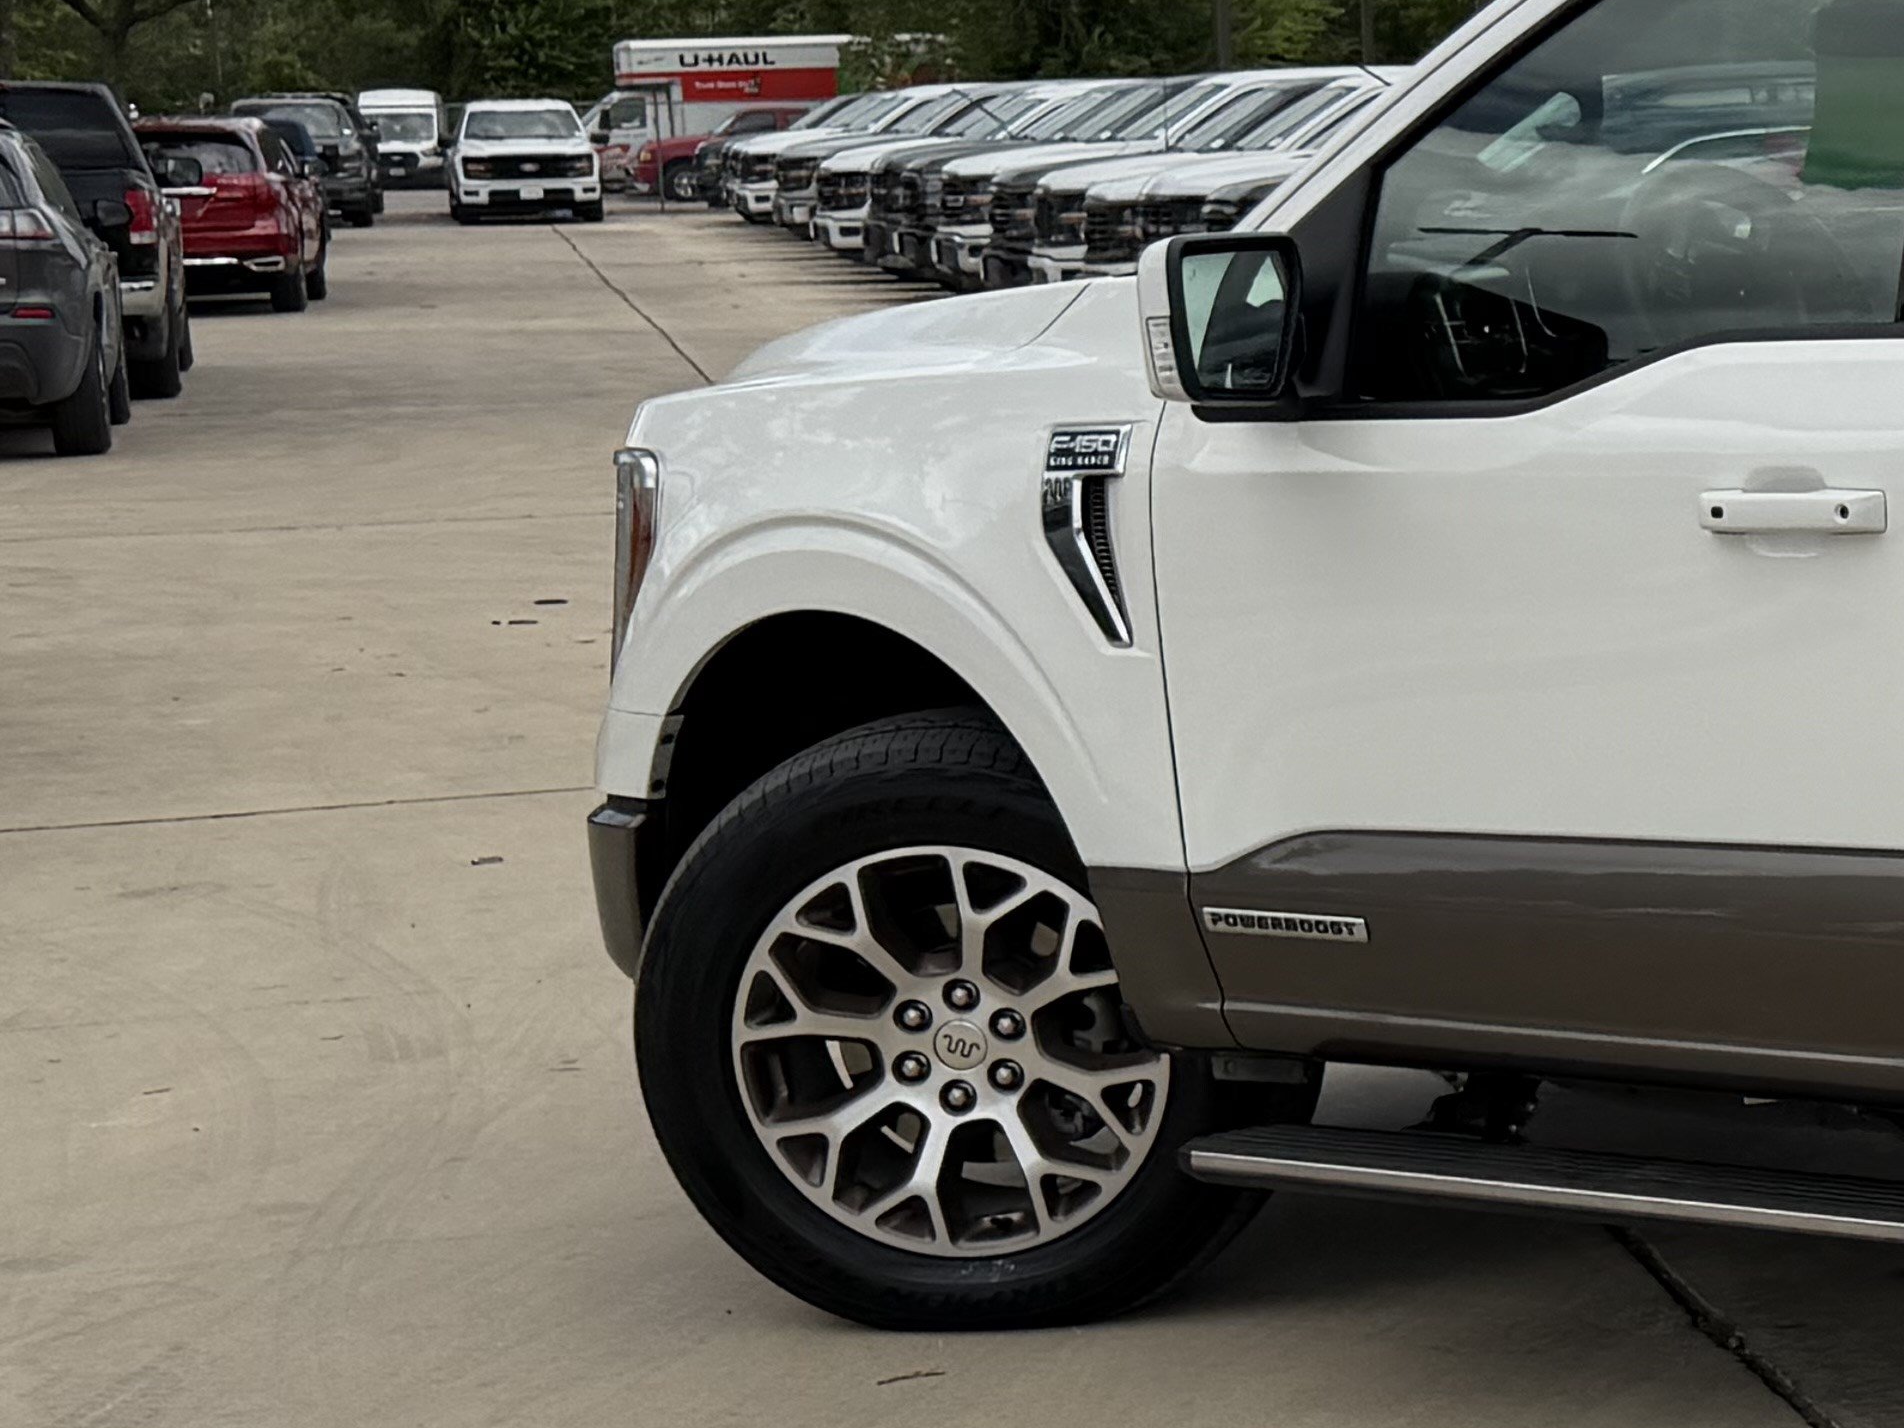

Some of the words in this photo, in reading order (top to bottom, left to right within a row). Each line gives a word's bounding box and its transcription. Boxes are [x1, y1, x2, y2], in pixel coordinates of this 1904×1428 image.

[679, 51, 776, 68] U-HAUL
[1049, 434, 1117, 453] F-150
[1209, 912, 1357, 936] POWERBOOST
